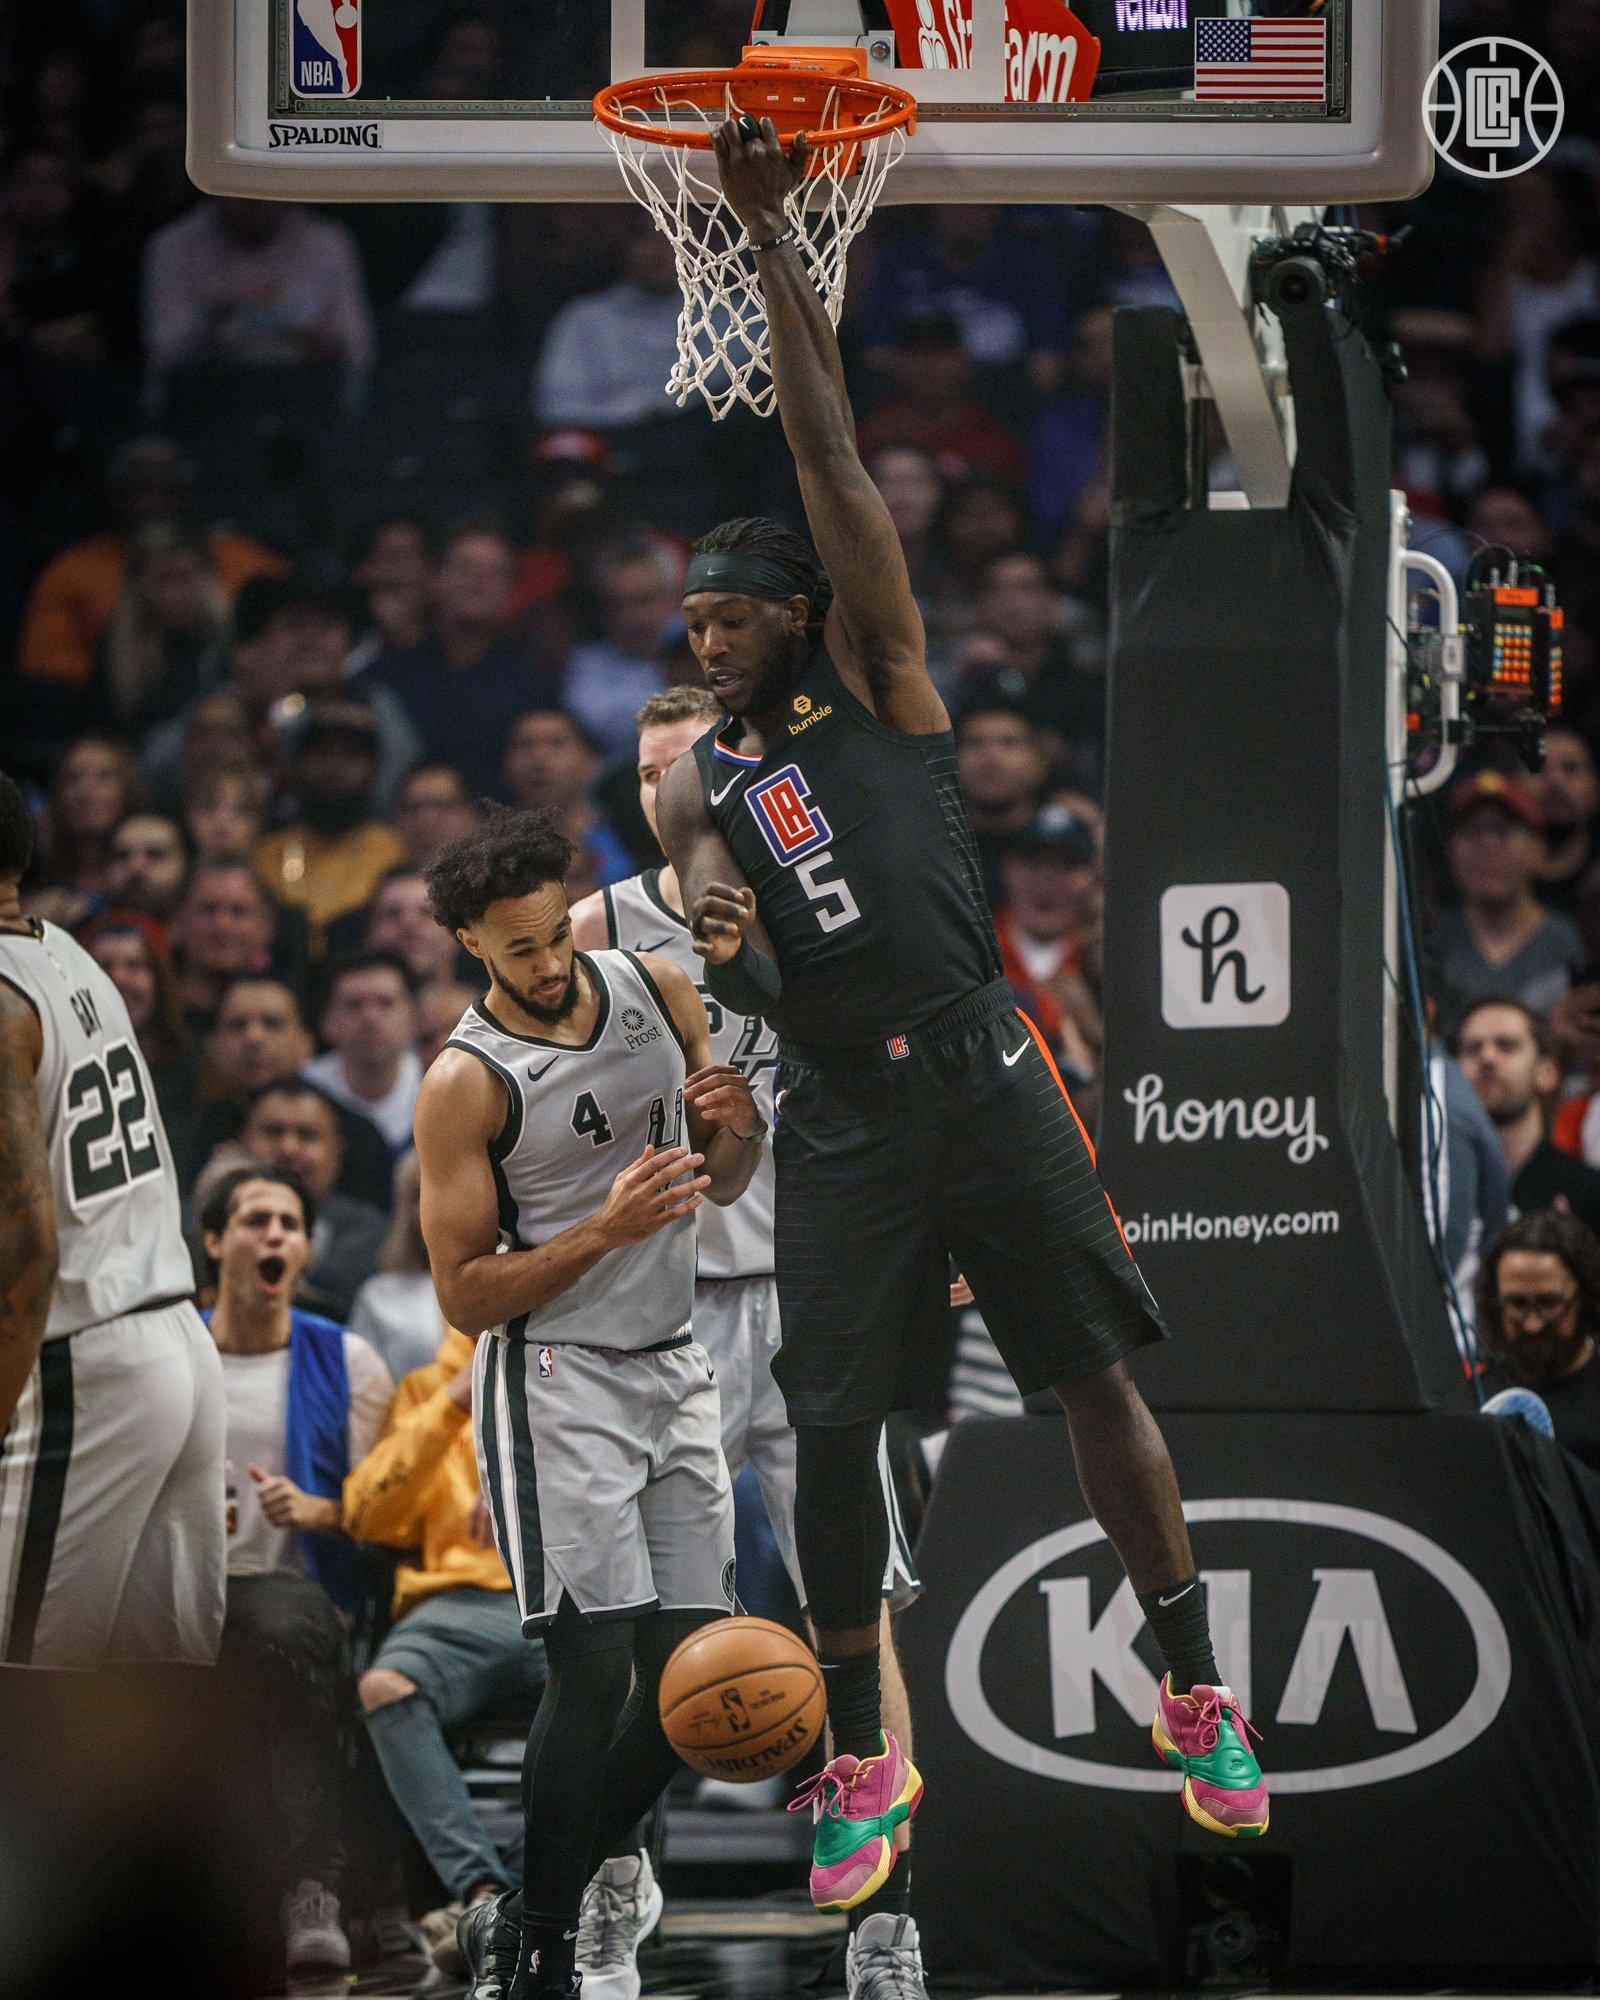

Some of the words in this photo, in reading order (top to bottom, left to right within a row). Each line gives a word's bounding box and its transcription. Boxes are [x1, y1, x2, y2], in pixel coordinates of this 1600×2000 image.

[301, 60, 334, 87] NBA
[1004, 27, 1077, 102] arm
[269, 123, 379, 149] SPALDING
[788, 704, 833, 736] bumble
[794, 850, 861, 933] 5
[624, 1024, 663, 1051] Frost
[64, 1036, 163, 1209] 22
[570, 1088, 616, 1149] 4
[1123, 1073, 1330, 1165] honey
[1116, 1210, 1340, 1245] oinHoney.com
[1038, 1569, 1417, 1738] KIA
